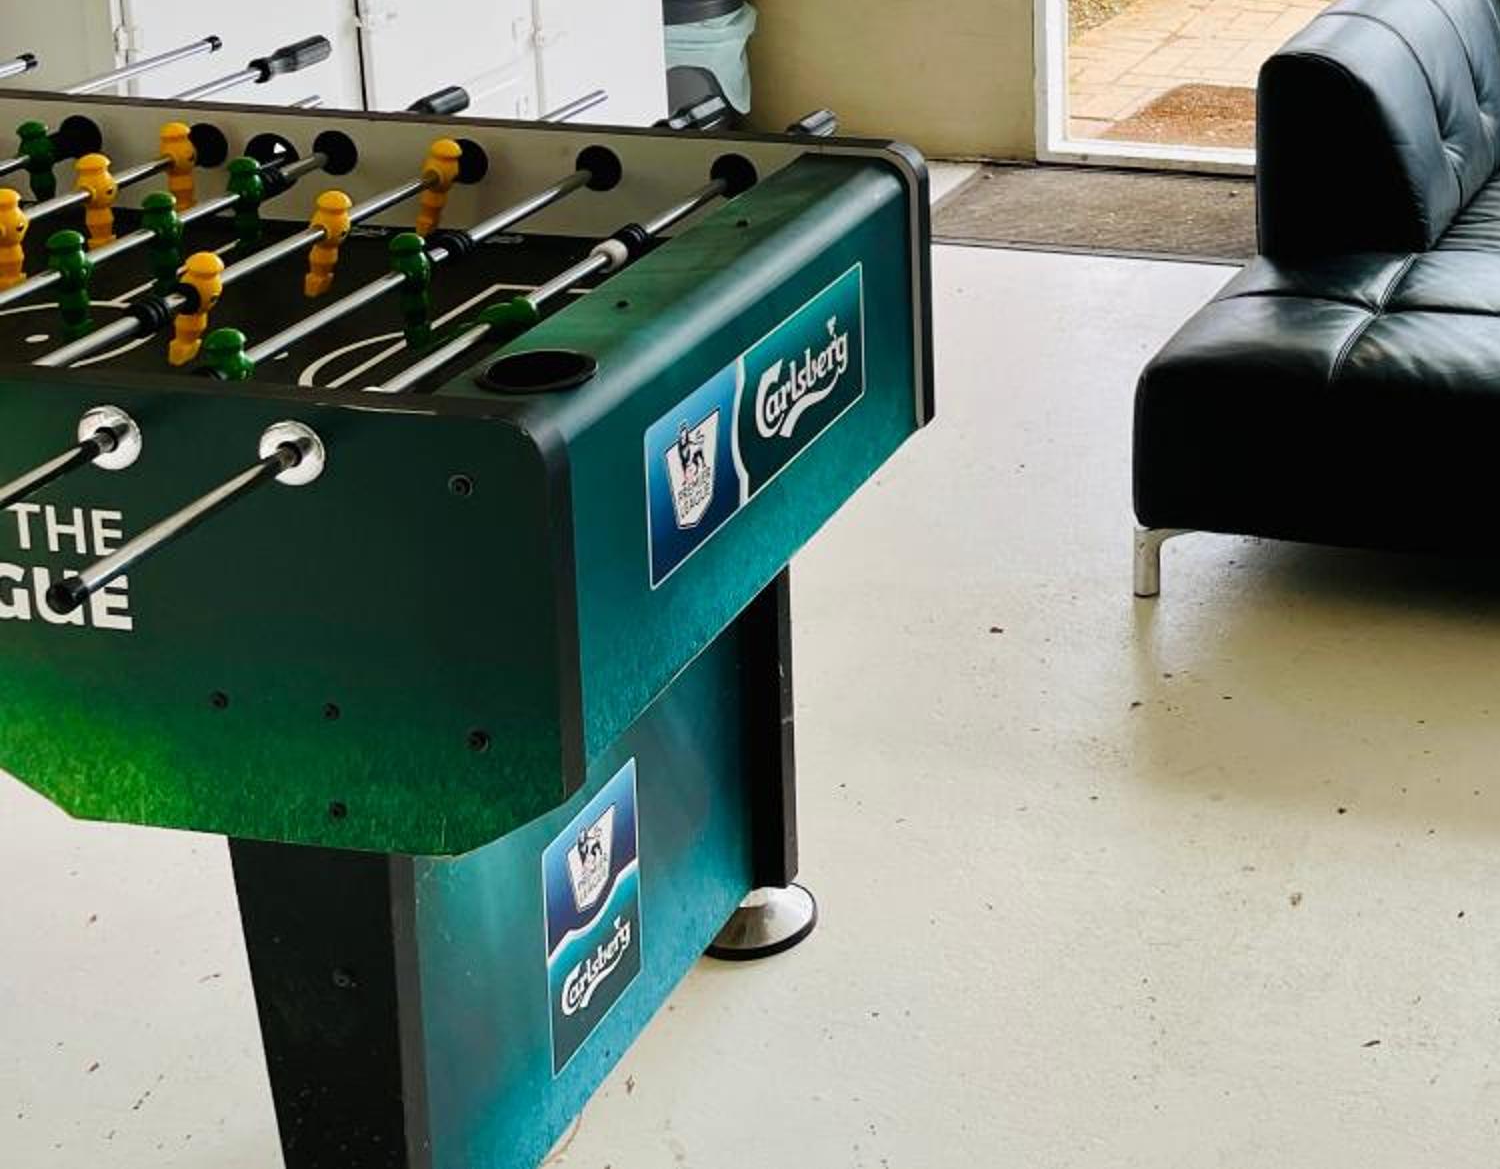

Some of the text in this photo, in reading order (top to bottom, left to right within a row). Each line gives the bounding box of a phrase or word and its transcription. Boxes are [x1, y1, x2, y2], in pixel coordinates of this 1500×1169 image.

[755, 317, 849, 438] Carlsberg
[5, 502, 123, 556] THE
[560, 917, 632, 1017] Carlsberg
